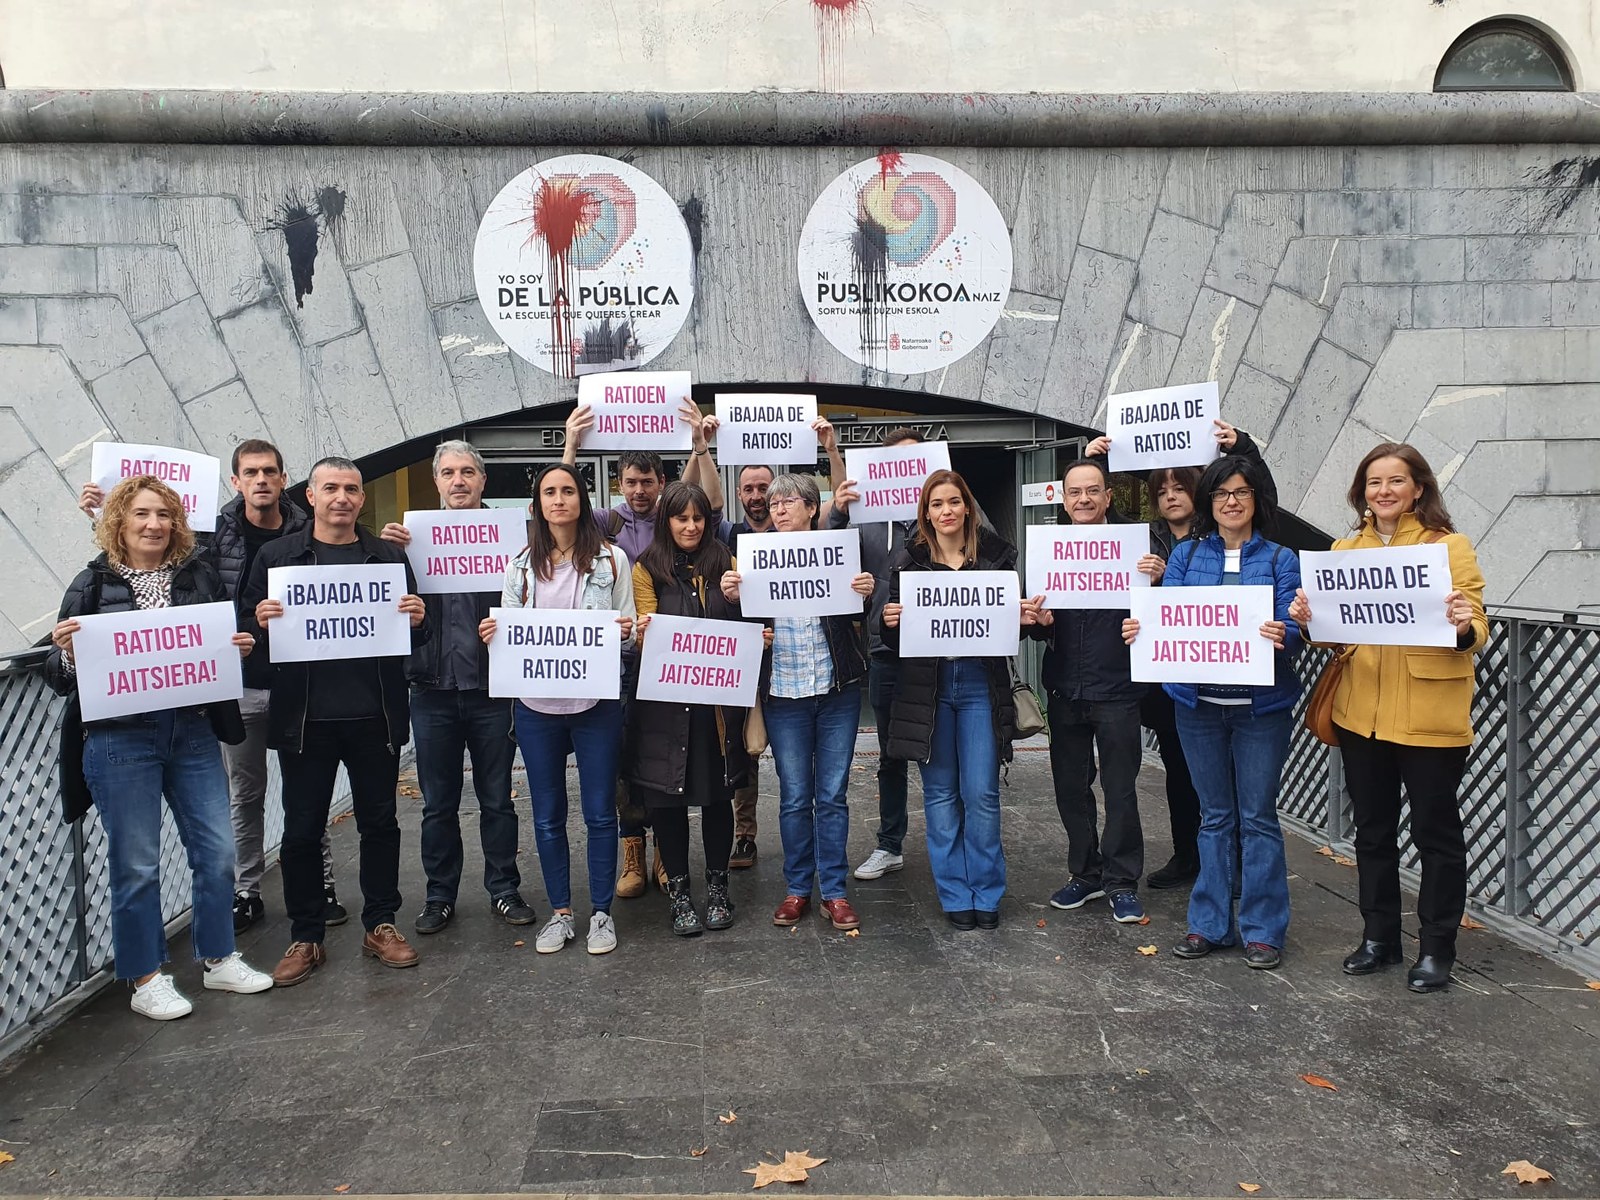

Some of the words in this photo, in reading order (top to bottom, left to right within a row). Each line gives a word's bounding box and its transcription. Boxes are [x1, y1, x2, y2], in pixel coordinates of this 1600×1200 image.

[498, 275, 515, 285] YO
[519, 275, 543, 285] SOY
[817, 271, 829, 281] NI
[498, 287, 529, 307] DE
[538, 287, 571, 307] LA
[580, 280, 680, 307] PÚBLICA
[818, 282, 970, 304] PUBLIKOKOA
[973, 292, 1001, 302] NAIZ
[499, 311, 512, 320] LA
[515, 311, 559, 320] ESCUELA
[561, 311, 583, 320] QUE
[585, 311, 627, 320] QUIERES
[629, 310, 661, 319] CREAR
[818, 307, 847, 315] SORTU
[874, 307, 904, 315] DUZUN
[905, 307, 940, 315] ESKOLA
[605, 386, 666, 404] RATIOEN
[730, 407, 784, 423] ¡BAJADA
[787, 406, 805, 423] DE
[1120, 401, 1181, 426] ¡BAJADA
[1184, 399, 1205, 419] DE
[598, 414, 674, 434] JAITSIERA!
[742, 432, 792, 450] RATIOS!
[1134, 431, 1192, 453] RATIOS!
[120, 459, 191, 482] RATIOEN
[868, 458, 927, 480] RATIOEN
[865, 487, 922, 508] JAITSIER
[432, 524, 500, 546] RATIOEN
[753, 549, 820, 570] ¡BAJADA
[823, 546, 845, 567] DE
[1053, 540, 1121, 561] RATIOEN
[1045, 571, 1130, 592] JAITSIERA!
[1315, 567, 1398, 591] ¡BAJADA
[1402, 564, 1431, 588] DE
[286, 582, 364, 606] ¡BAJADA
[368, 580, 392, 603] DE
[769, 578, 831, 600] RATIOS!
[916, 587, 982, 607] ¡BAJADA
[985, 586, 1006, 607] DE
[1160, 604, 1239, 627] RATIOEN
[1339, 602, 1416, 625] RATIOS!
[113, 623, 203, 656] RATIOEN
[305, 616, 375, 641] RATIOS!
[507, 625, 578, 647] ¡BAJADA
[582, 626, 605, 647] DE
[930, 618, 990, 639] RATIOS!
[671, 632, 738, 657] RATIOEN
[1151, 640, 1250, 663] JAITSIERA!
[107, 659, 217, 696] JAITSIERA!
[523, 658, 588, 680] RATIOS!
[658, 663, 742, 689] JAITSIERA!
